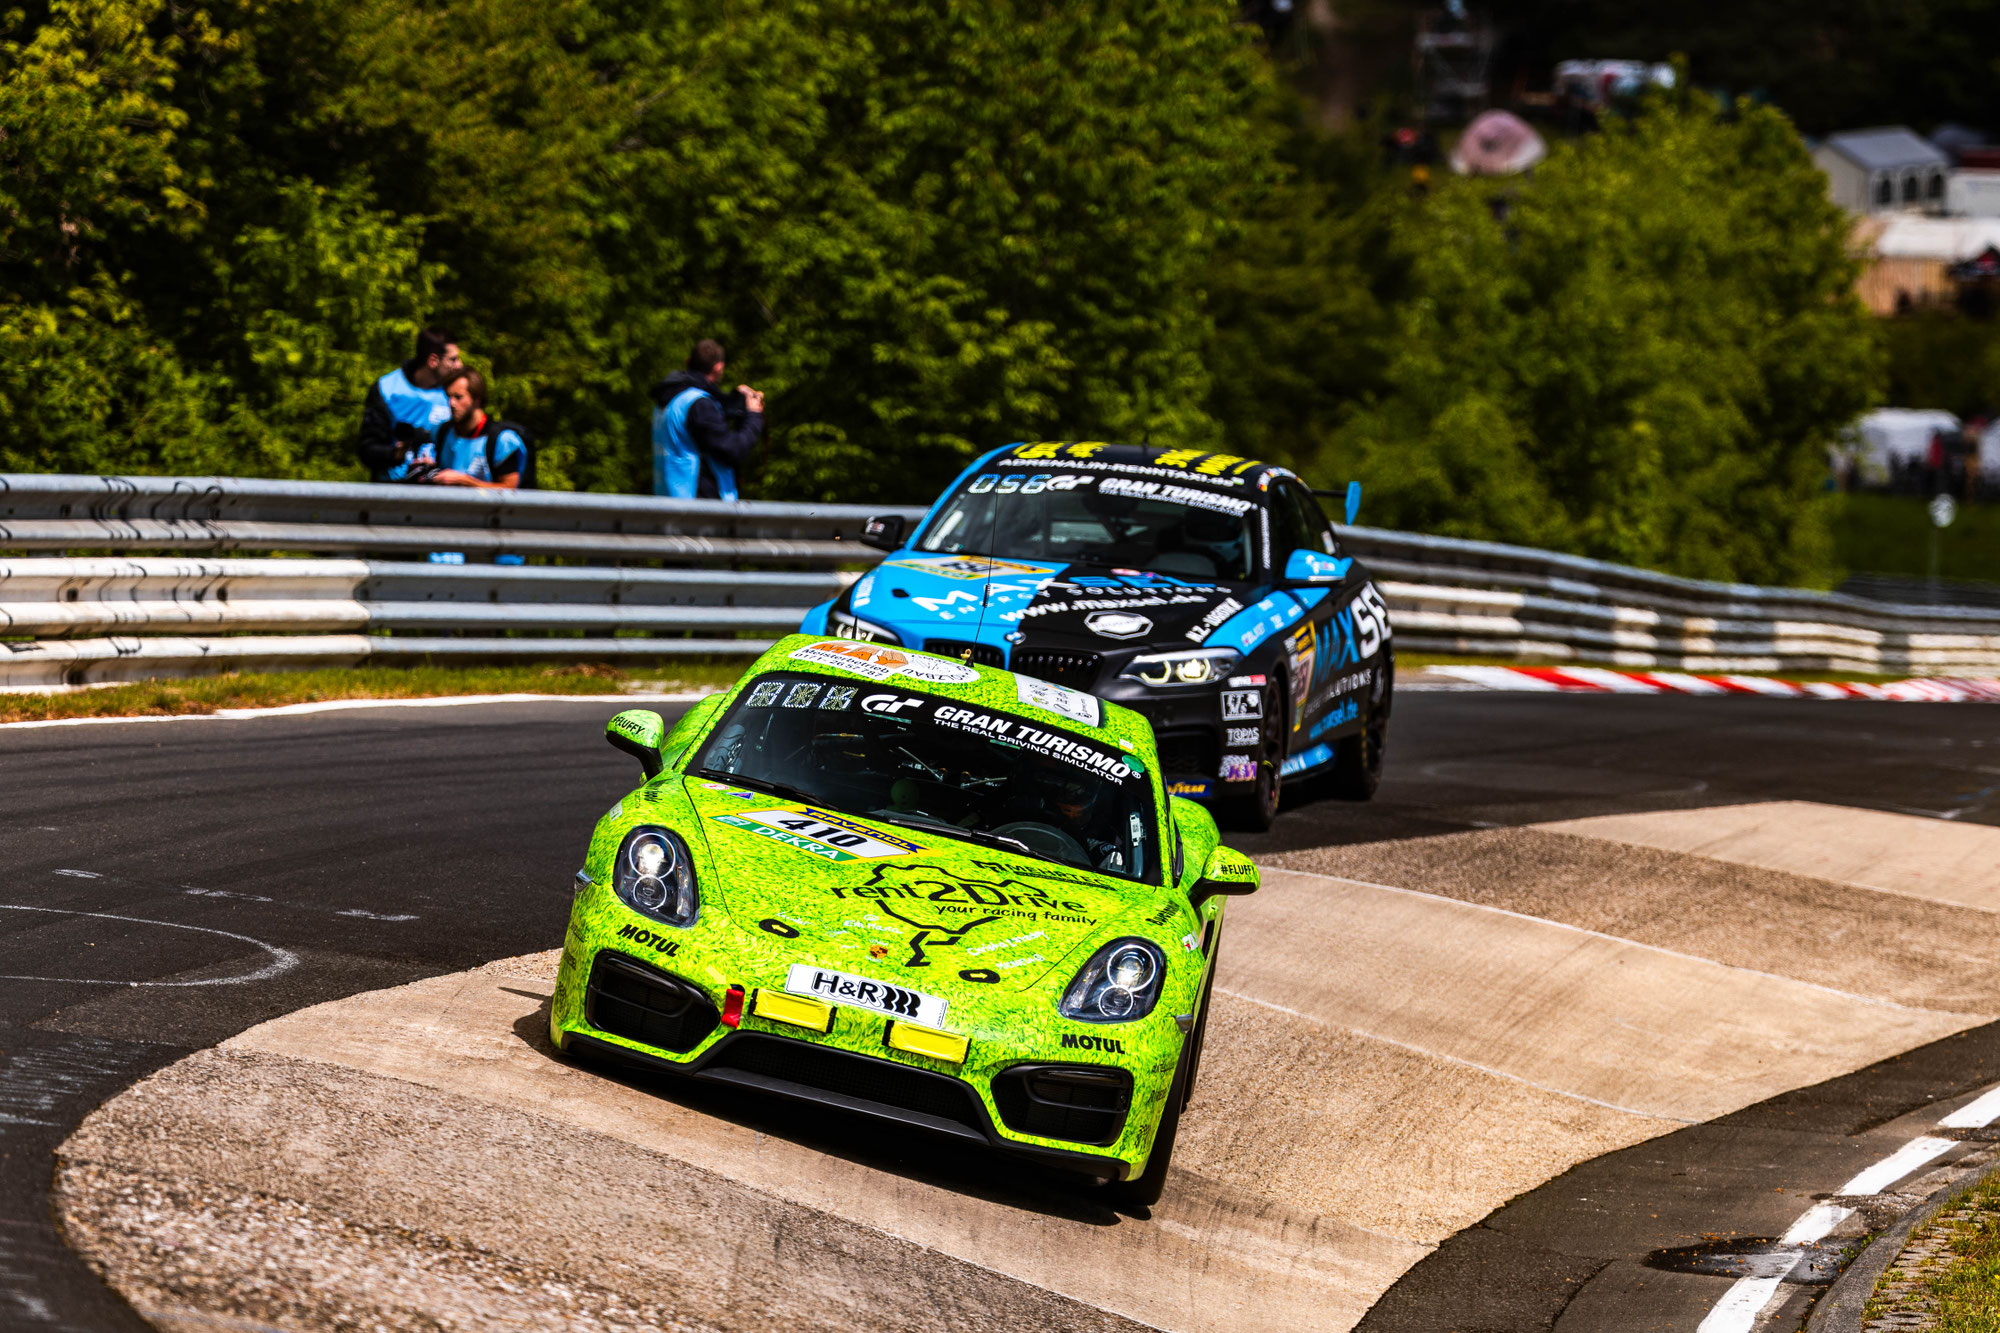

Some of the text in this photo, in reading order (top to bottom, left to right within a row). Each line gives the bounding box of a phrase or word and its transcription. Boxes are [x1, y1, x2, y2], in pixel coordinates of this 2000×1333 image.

[1099, 477, 1252, 512] GRAN TURISMO
[802, 648, 890, 674] Meisterbetrieb
[810, 643, 906, 665] MAY
[611, 716, 646, 735] #FLUFFY
[933, 705, 1132, 780] GRAN TURISMO
[933, 719, 1123, 786] THE REAL DRIVING SIMULATOR
[749, 825, 840, 861] DEKRA
[777, 819, 868, 848] 410
[808, 810, 912, 850] RAVENOL
[830, 880, 1088, 914] rent2Drive
[935, 903, 1097, 926] your racing family
[617, 924, 682, 958] MOTUL
[813, 971, 879, 1003] H&R
[1061, 1033, 1126, 1055] MOTUL
